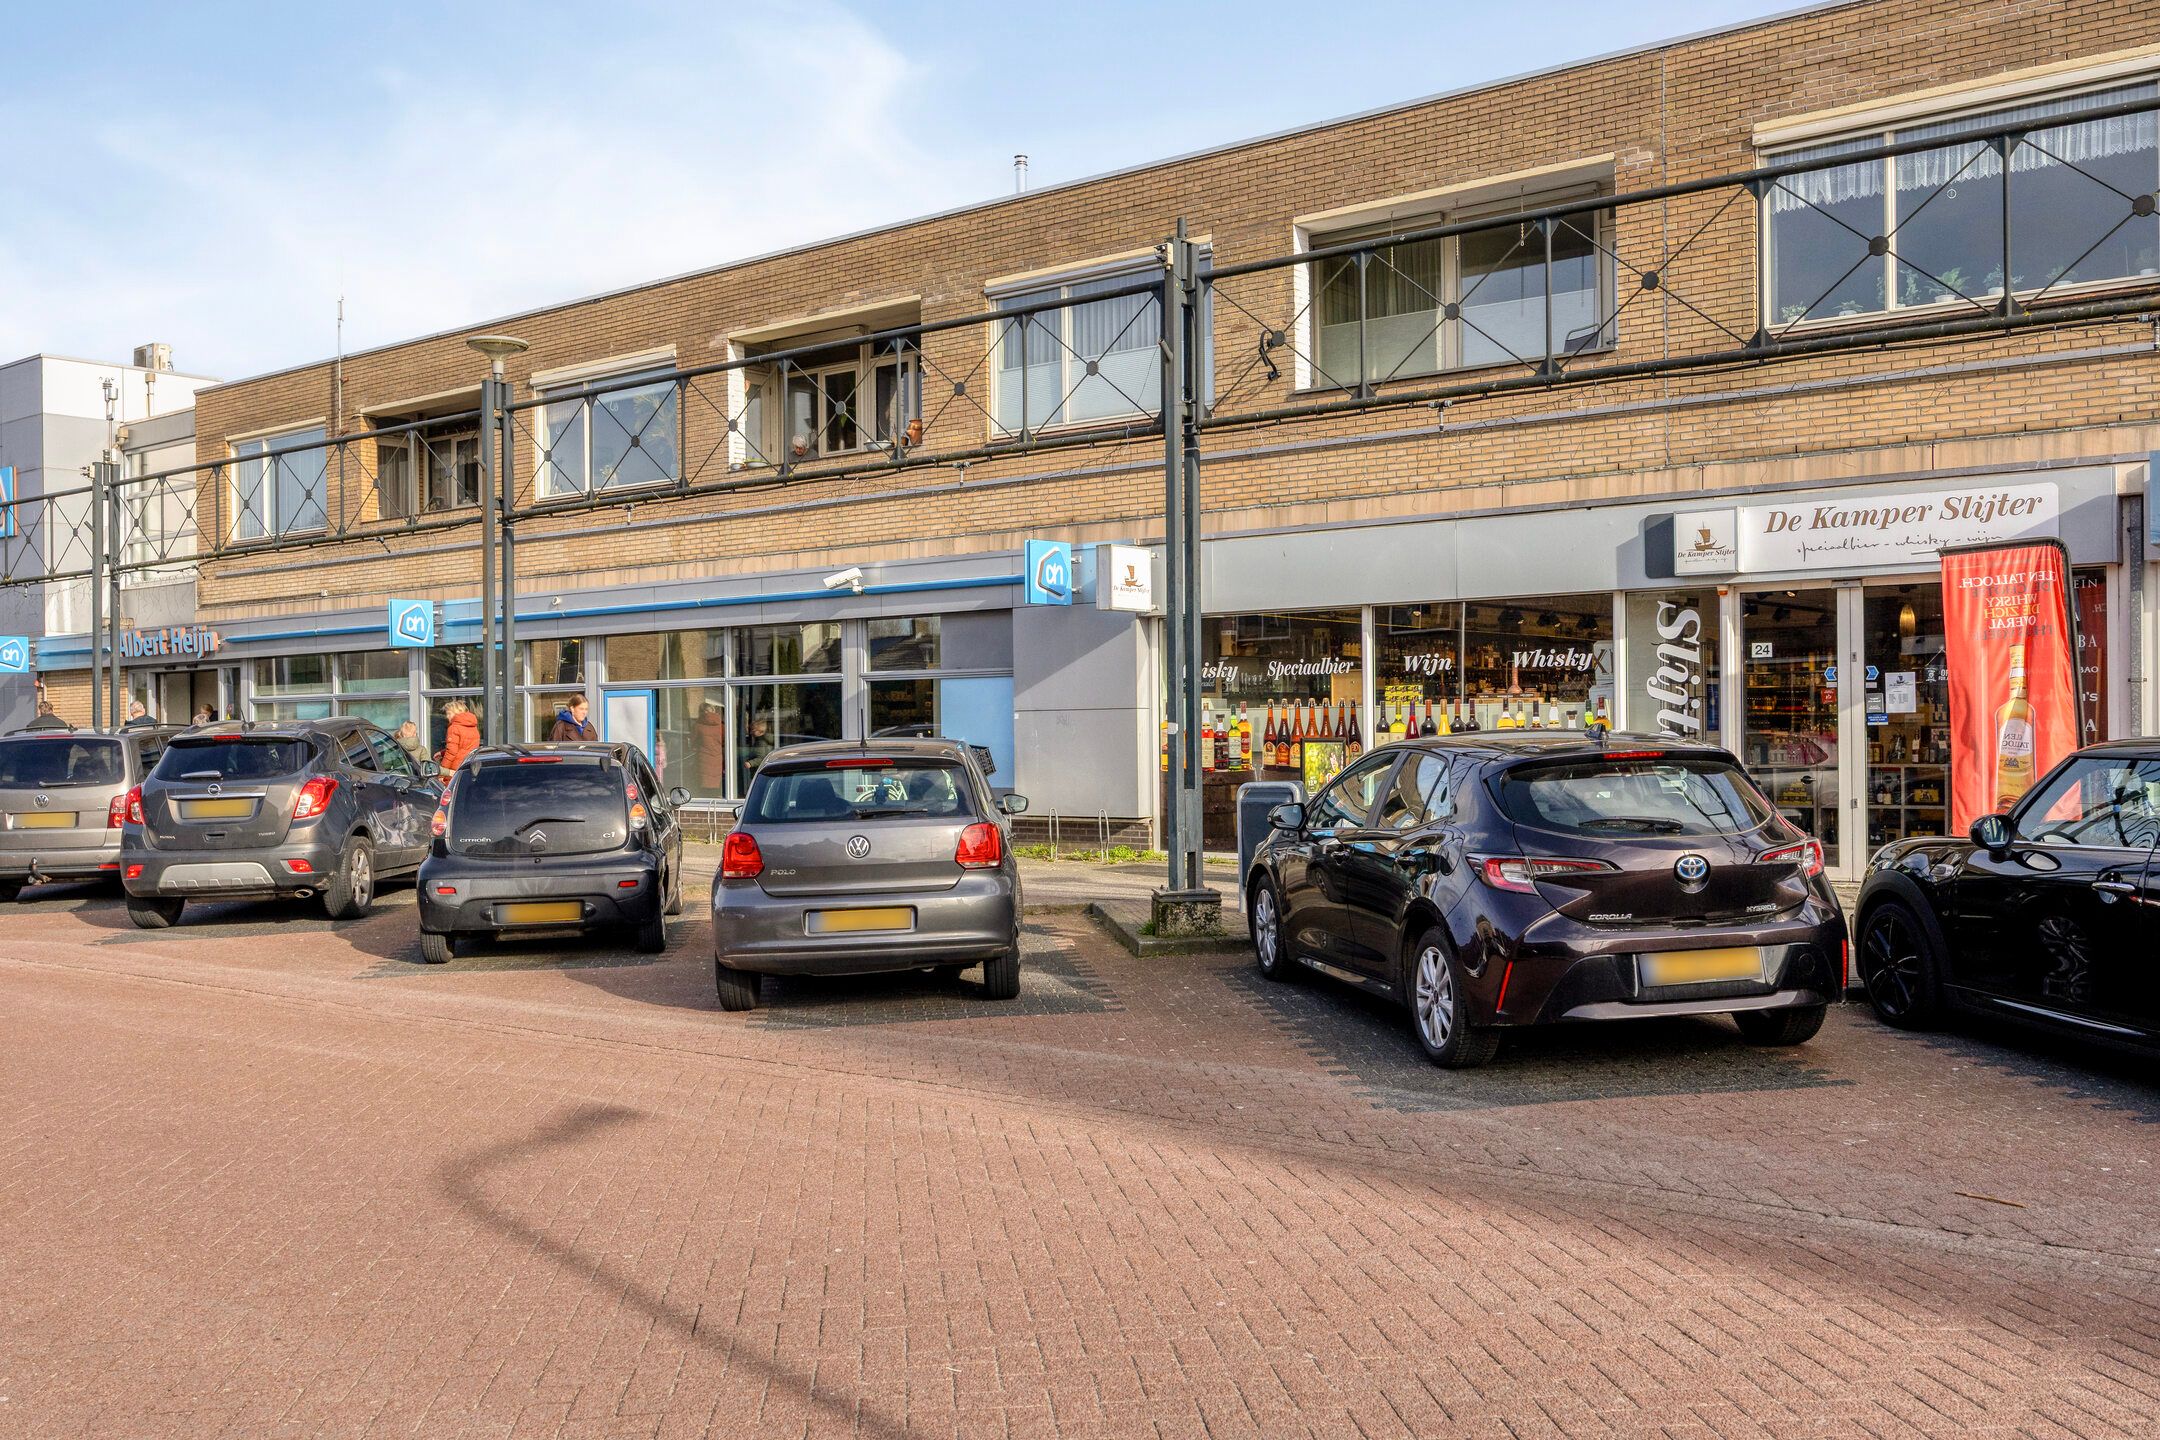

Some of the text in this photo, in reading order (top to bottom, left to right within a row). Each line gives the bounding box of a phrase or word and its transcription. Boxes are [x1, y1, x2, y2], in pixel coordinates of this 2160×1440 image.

[1764, 492, 2043, 534] De Kamper Slijter
[1895, 533, 1950, 547] whisky
[2073, 579, 2098, 589] EIN
[120, 625, 216, 659] Albert Heijn
[1754, 645, 1770, 655] 24
[2078, 634, 2098, 648] BA
[1267, 657, 1354, 682] Speciaalbier
[1403, 652, 1453, 676] Wijn
[1512, 647, 1593, 672] Whisky
[1647, 600, 1701, 737] Slijt
[1201, 661, 1239, 682] isky
[1588, 913, 1633, 921] COROLLA
